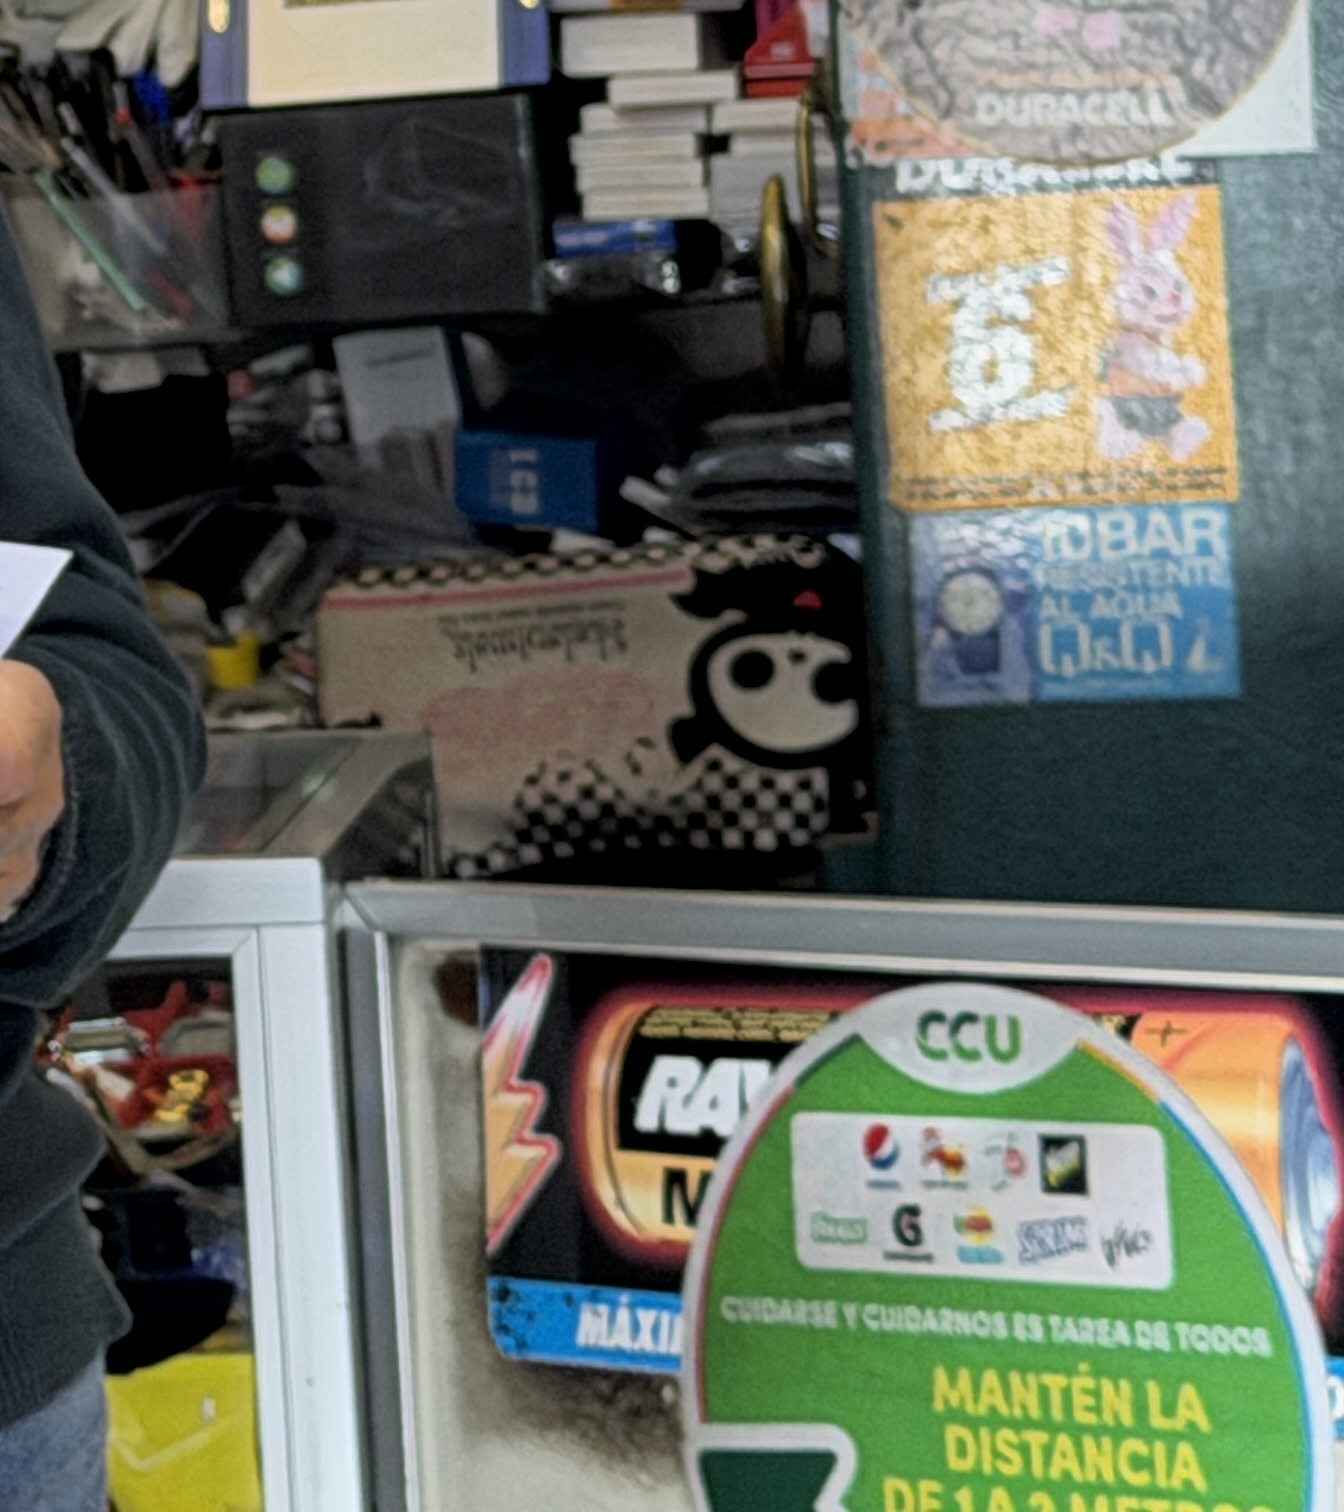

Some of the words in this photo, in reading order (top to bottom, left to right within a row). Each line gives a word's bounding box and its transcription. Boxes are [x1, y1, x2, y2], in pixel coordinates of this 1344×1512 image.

[975, 91, 1173, 126] DURACELL
[916, 1009, 1021, 1064] CCU
[721, 1294, 839, 1330] CUIDARSE
[842, 1303, 860, 1331] Y
[861, 1304, 1009, 1341] CUIDARNOS
[1012, 1311, 1044, 1342] ES
[1045, 1313, 1132, 1350] TAREA
[1134, 1320, 1171, 1351] DE
[1176, 1321, 1273, 1358] TODOS
[931, 1360, 1135, 1428] MANTÉN
[1146, 1379, 1212, 1434] LA
[944, 1423, 1208, 1494] DISTANCIA
